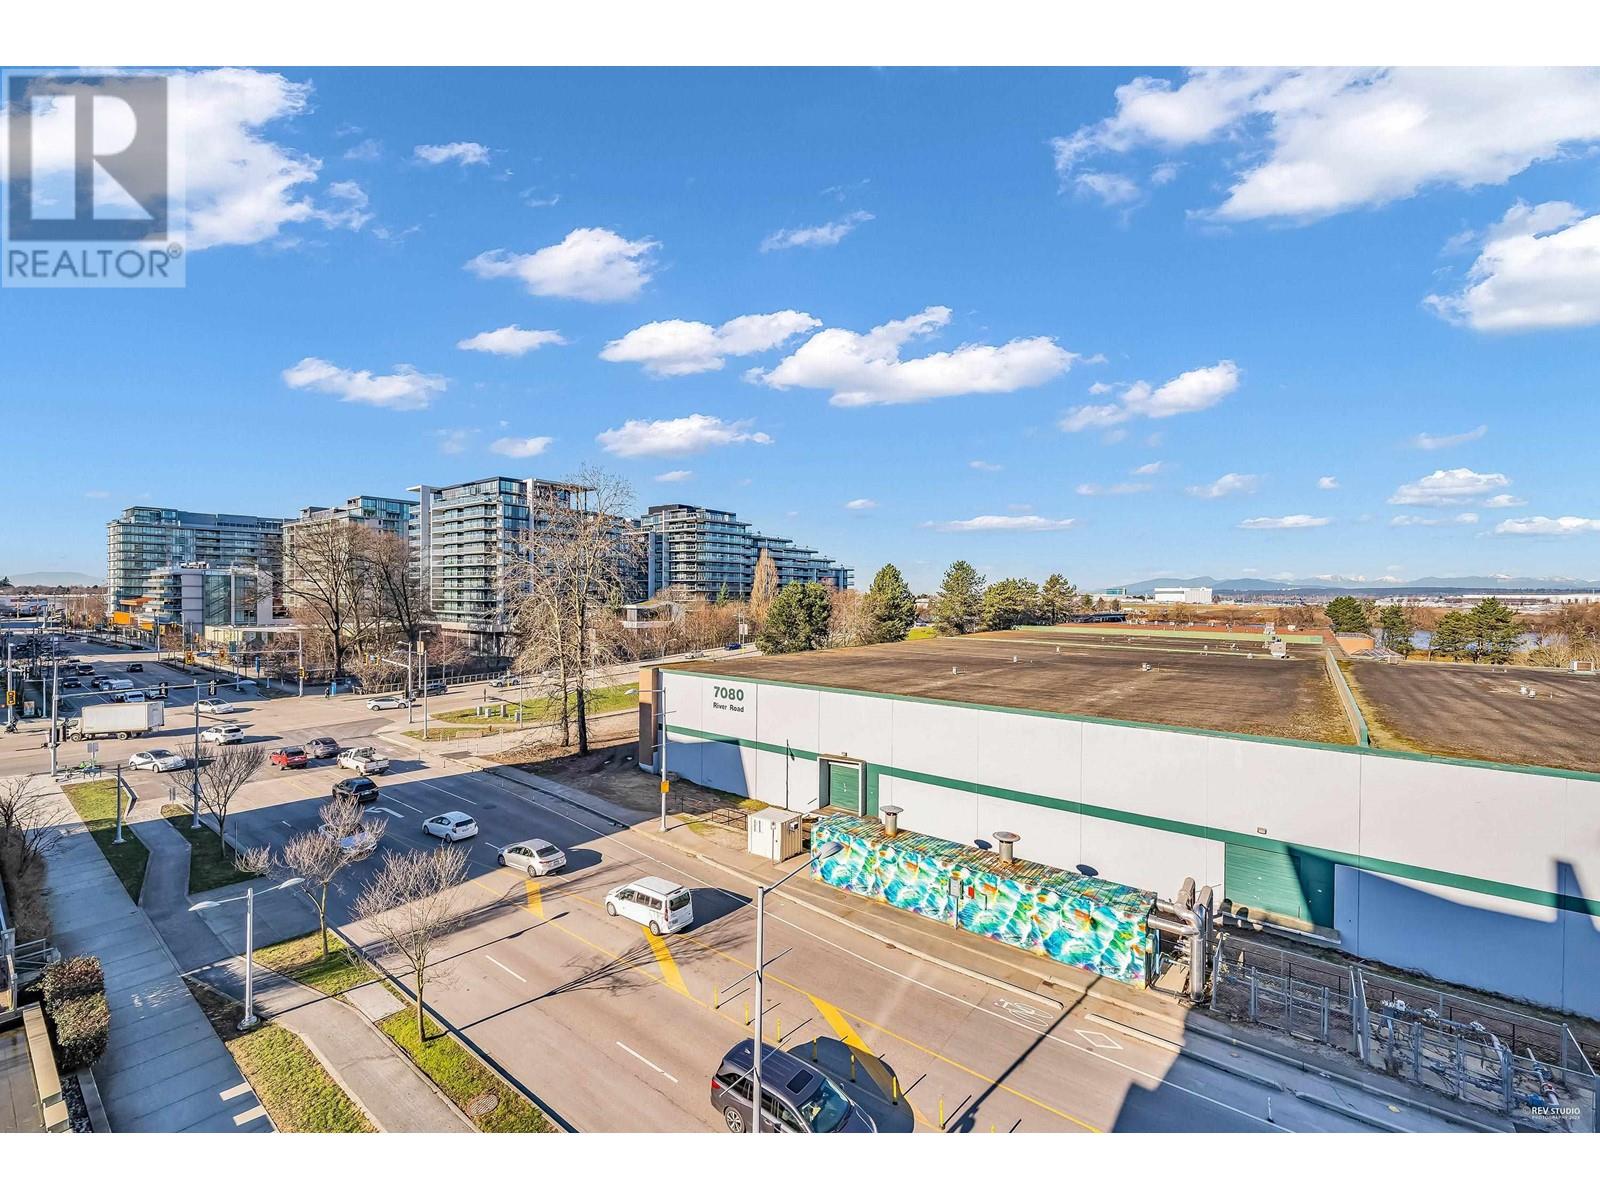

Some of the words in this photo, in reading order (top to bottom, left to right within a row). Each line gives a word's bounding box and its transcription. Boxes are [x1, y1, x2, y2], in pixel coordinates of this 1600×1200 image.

[713, 686, 744, 701] 7080
[713, 702, 728, 710] River
[729, 704, 745, 712] Road
